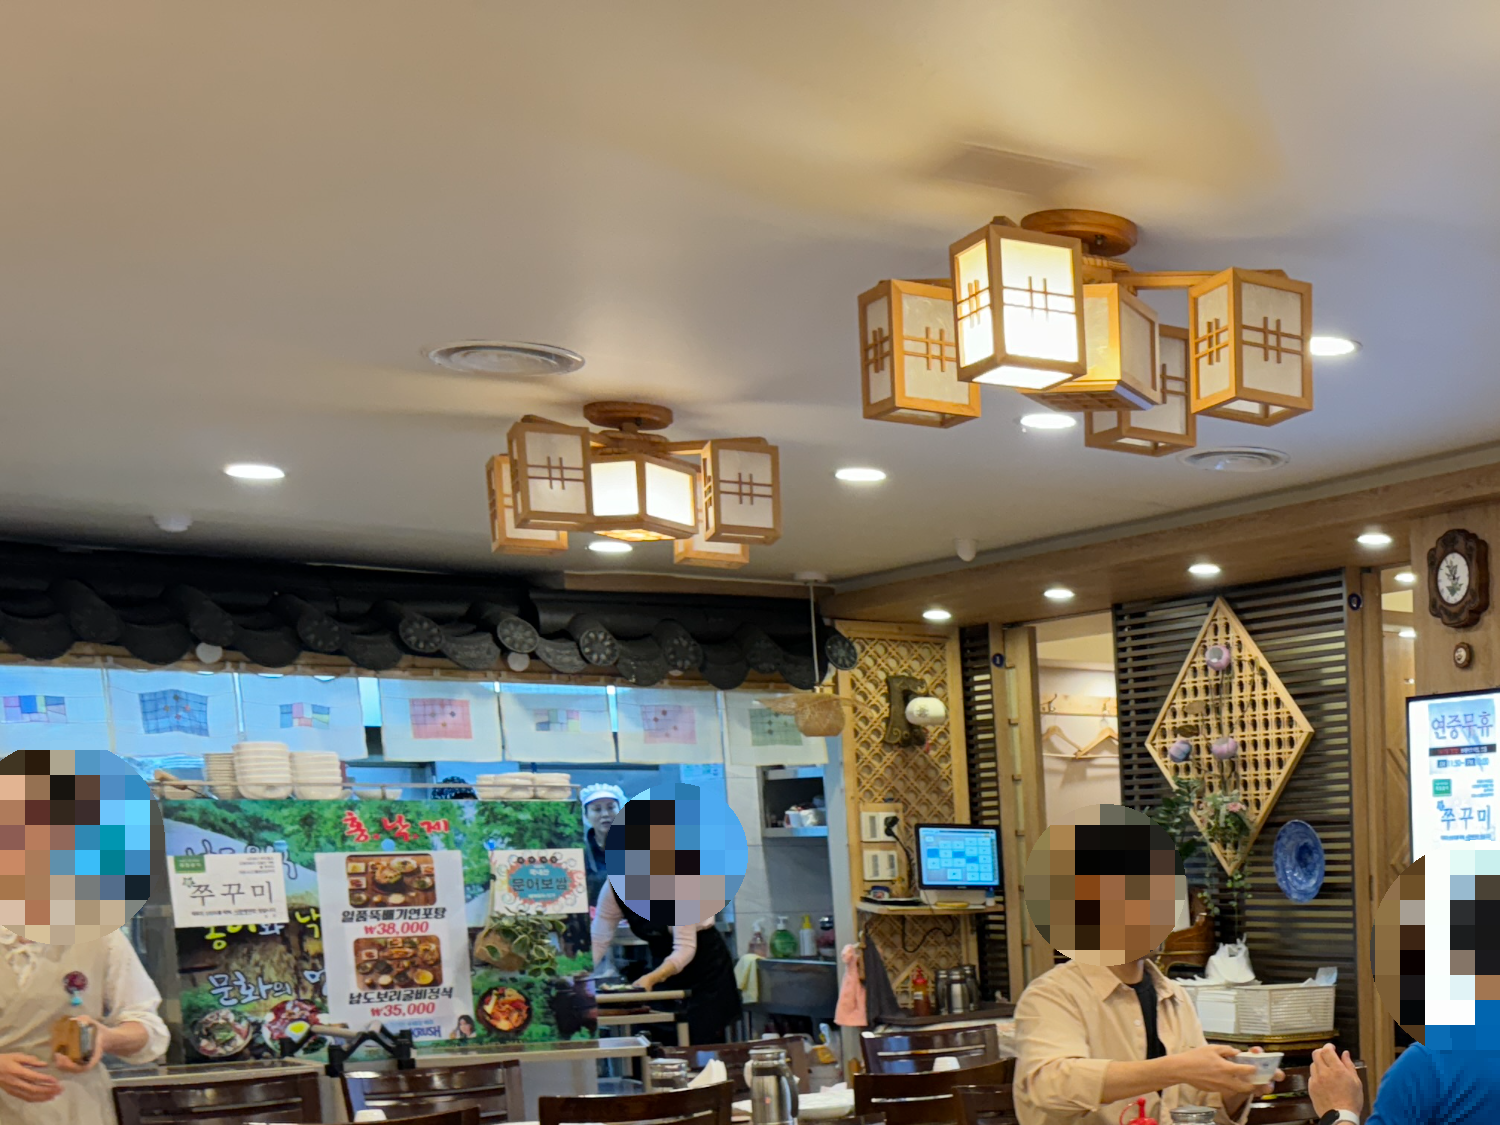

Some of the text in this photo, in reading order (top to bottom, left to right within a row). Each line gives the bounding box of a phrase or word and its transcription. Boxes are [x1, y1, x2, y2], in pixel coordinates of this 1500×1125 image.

[1431, 711, 1493, 740] 연중무휴
[1440, 804, 1491, 831] 쭈꾸미
[189, 880, 274, 907] 쭈꾸미
[512, 876, 568, 892] 문어보쌈
[208, 971, 293, 1007] 문화의
[370, 1001, 436, 1018] ₩35,000
